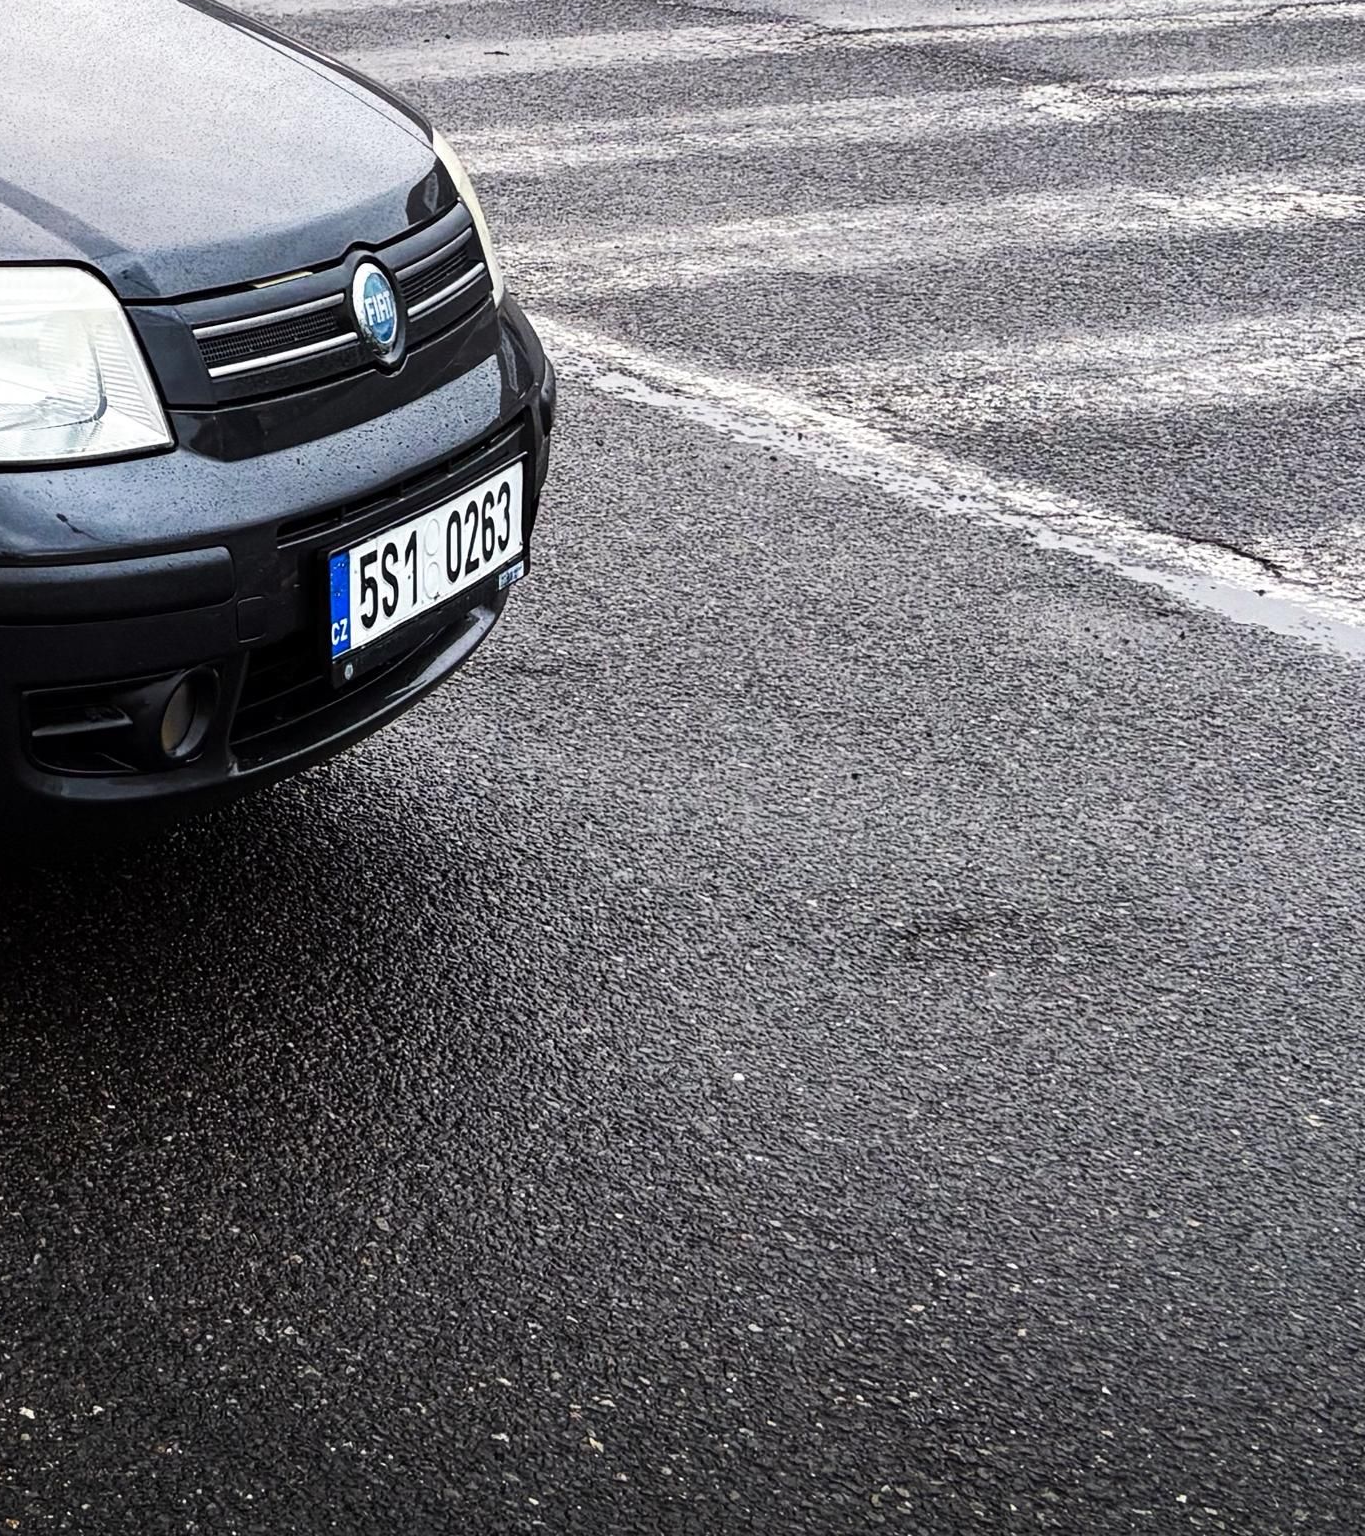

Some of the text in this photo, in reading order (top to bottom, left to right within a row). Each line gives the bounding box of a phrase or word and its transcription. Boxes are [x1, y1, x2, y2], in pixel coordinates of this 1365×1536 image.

[364, 290, 393, 326] FIAT
[359, 481, 511, 629] 5S1 0263
[331, 617, 349, 645] CZ
